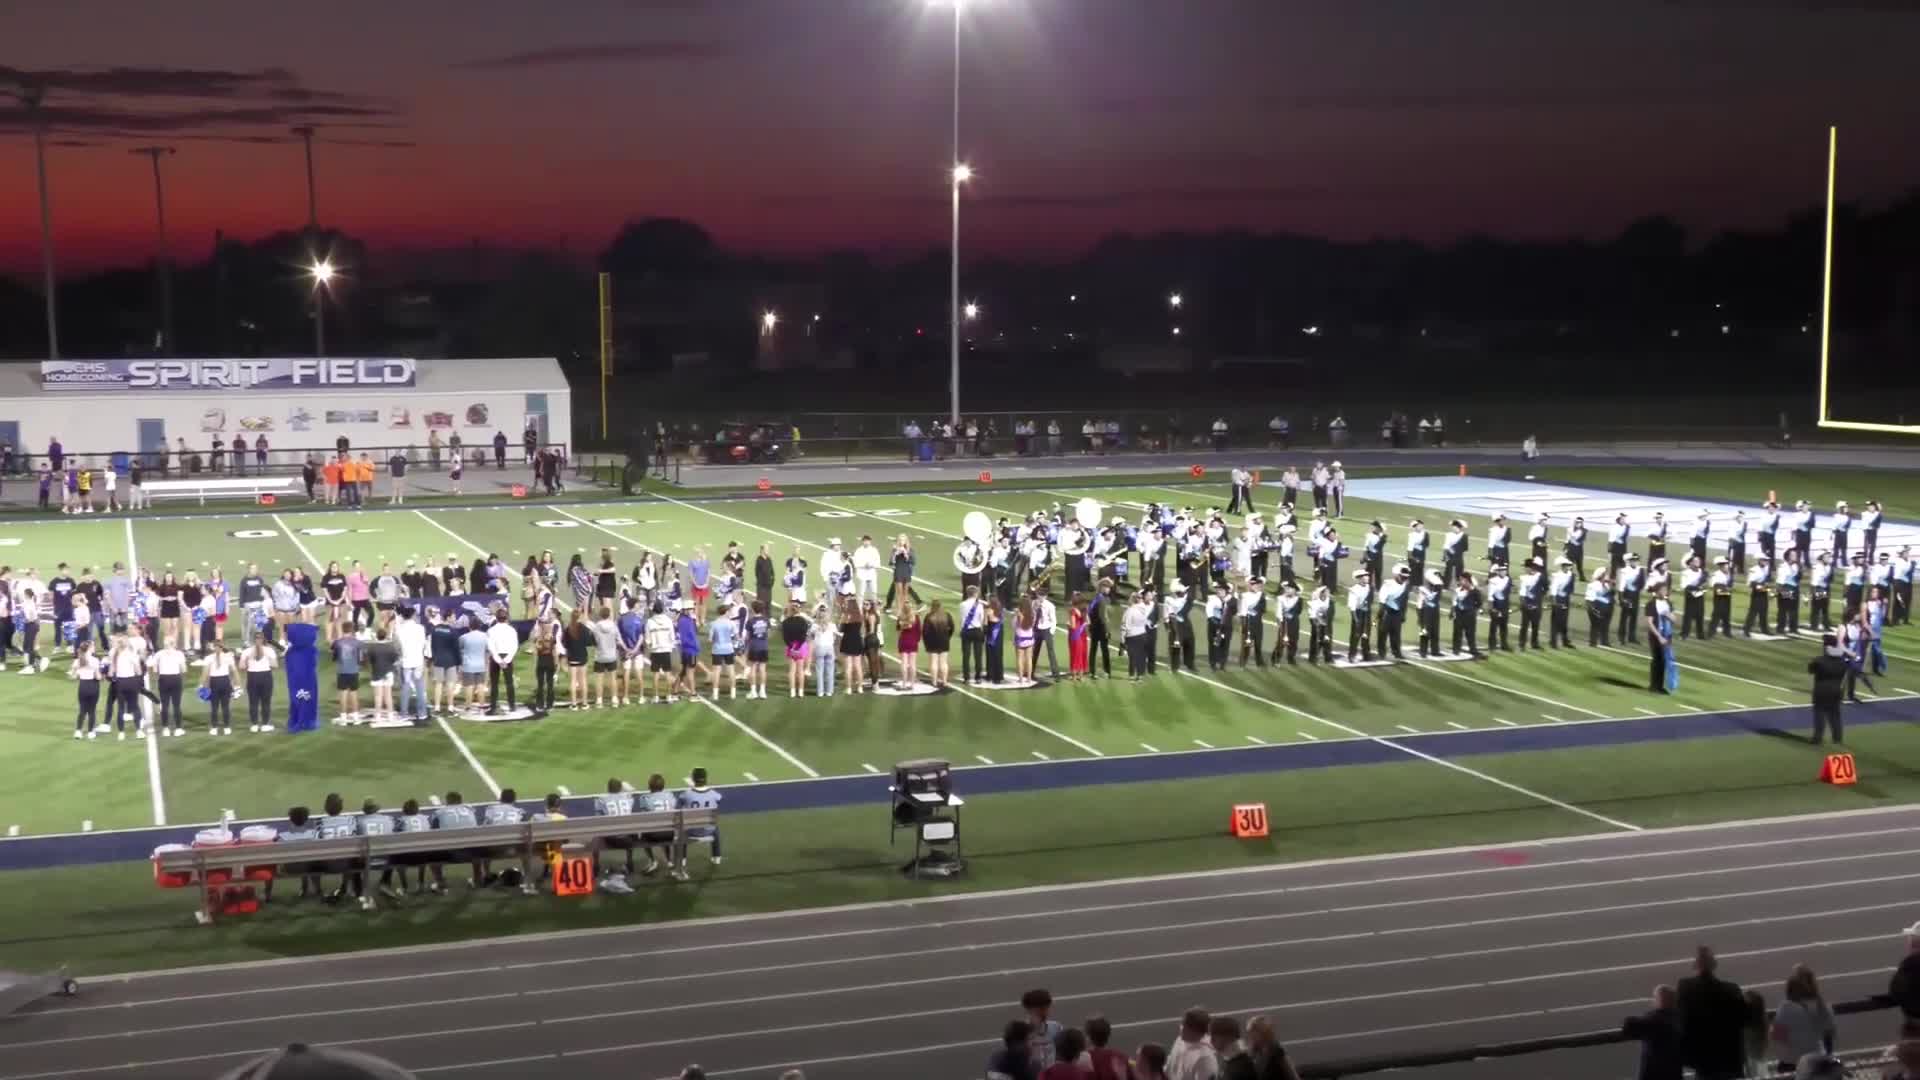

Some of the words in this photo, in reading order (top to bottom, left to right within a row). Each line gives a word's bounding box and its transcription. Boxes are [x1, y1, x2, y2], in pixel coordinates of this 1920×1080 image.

[45, 373, 125, 382] HOMECOMING
[128, 359, 269, 388] SPIRIT
[291, 358, 413, 385] FIELD
[1831, 755, 1854, 779] 20
[1238, 807, 1265, 832] 30
[558, 859, 588, 889] 40
